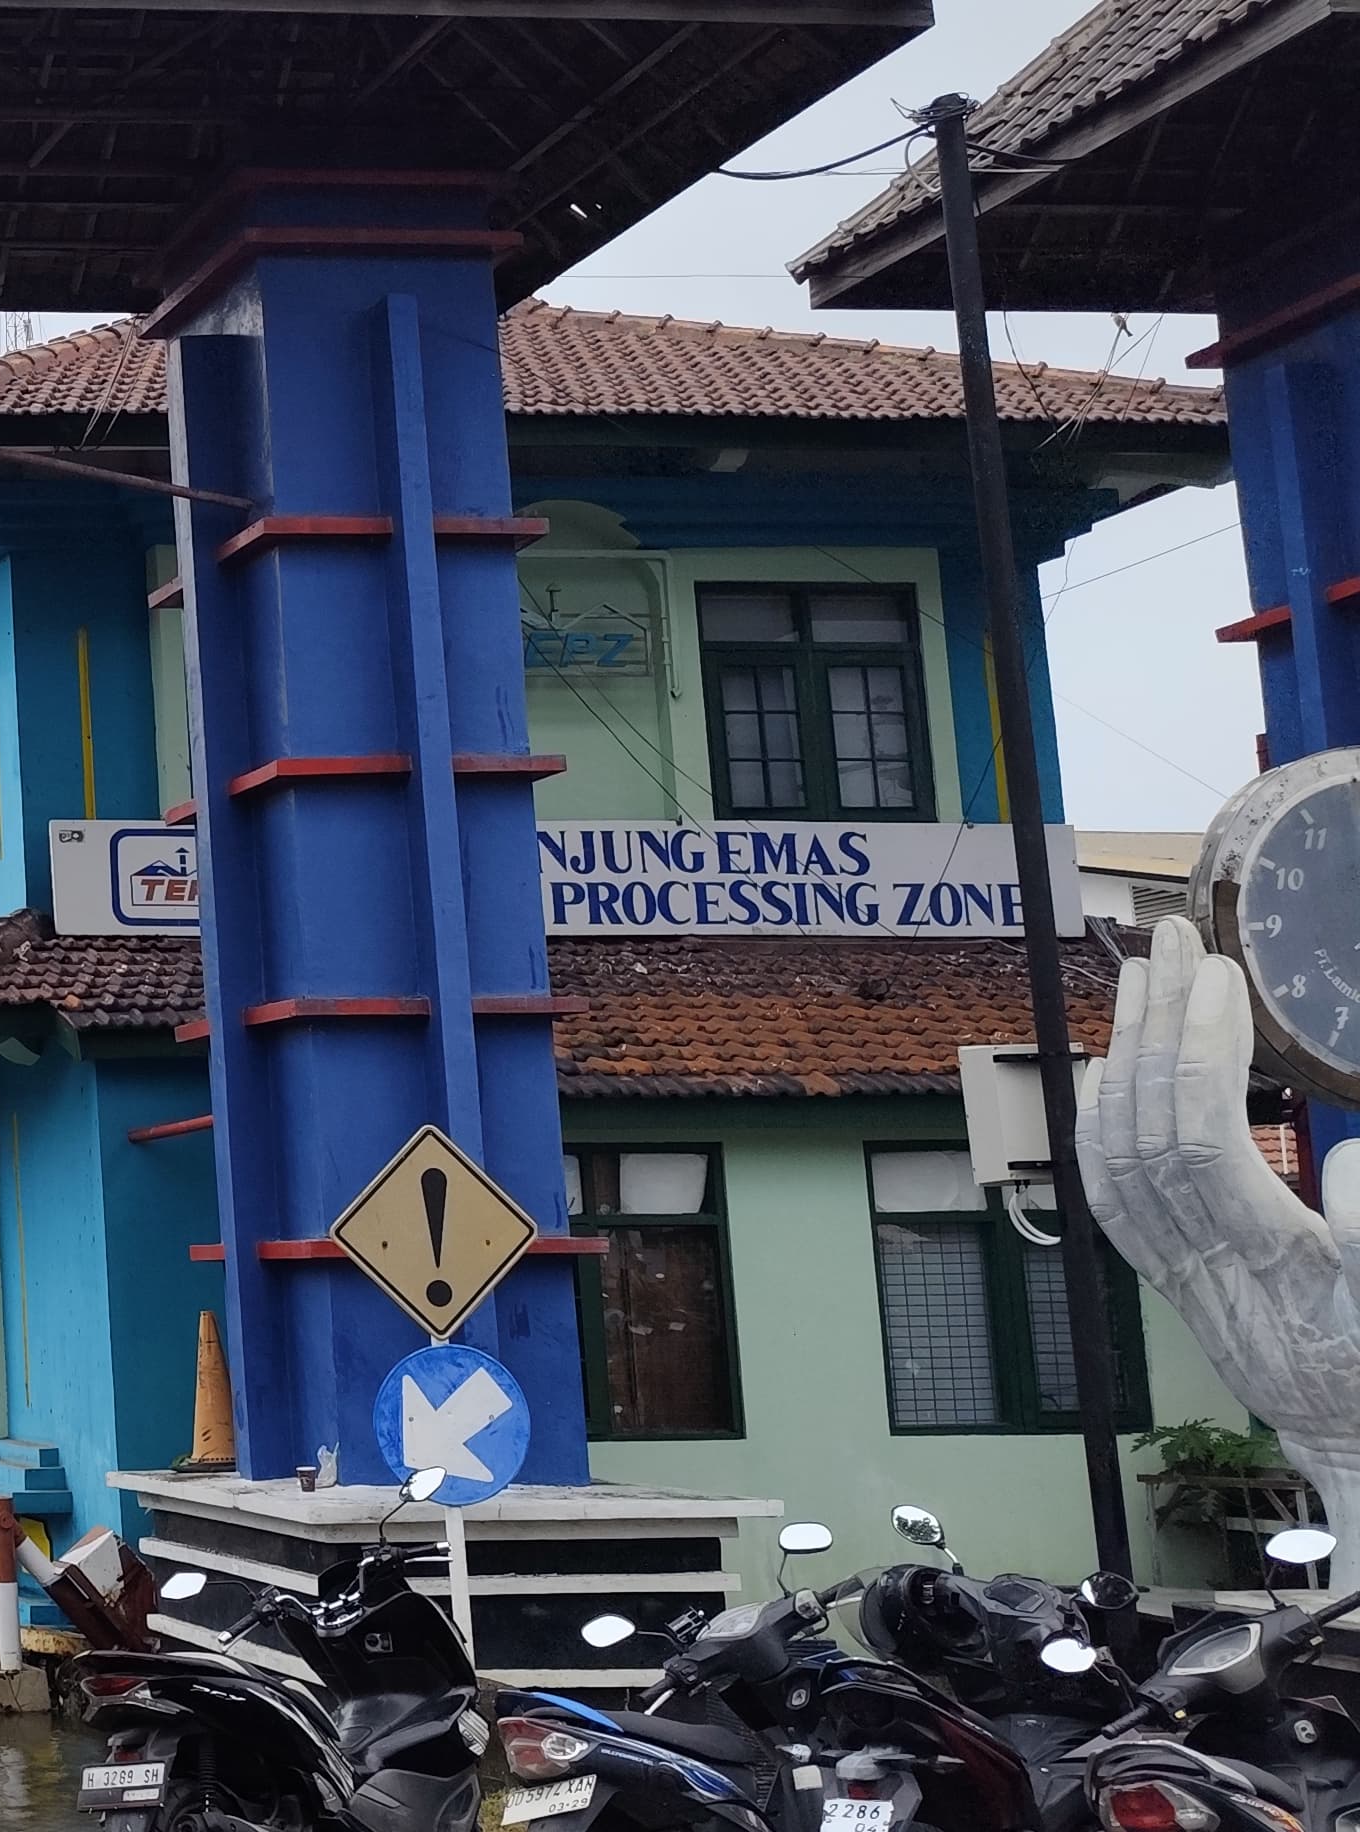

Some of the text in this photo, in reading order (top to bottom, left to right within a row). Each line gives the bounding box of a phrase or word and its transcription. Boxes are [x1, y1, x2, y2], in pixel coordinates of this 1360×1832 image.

[1303, 827, 1327, 850] 11
[714, 831, 871, 877] EMAS
[1276, 867, 1305, 891] 10
[549, 879, 880, 927] PROCESSING
[1265, 913, 1283, 938] 9
[1291, 973, 1307, 999] 8
[1334, 1006, 1350, 1030] 7
[87, 1772, 95, 1788] H
[143, 1768, 159, 1784] SH
[828, 1803, 881, 1820] 2286
